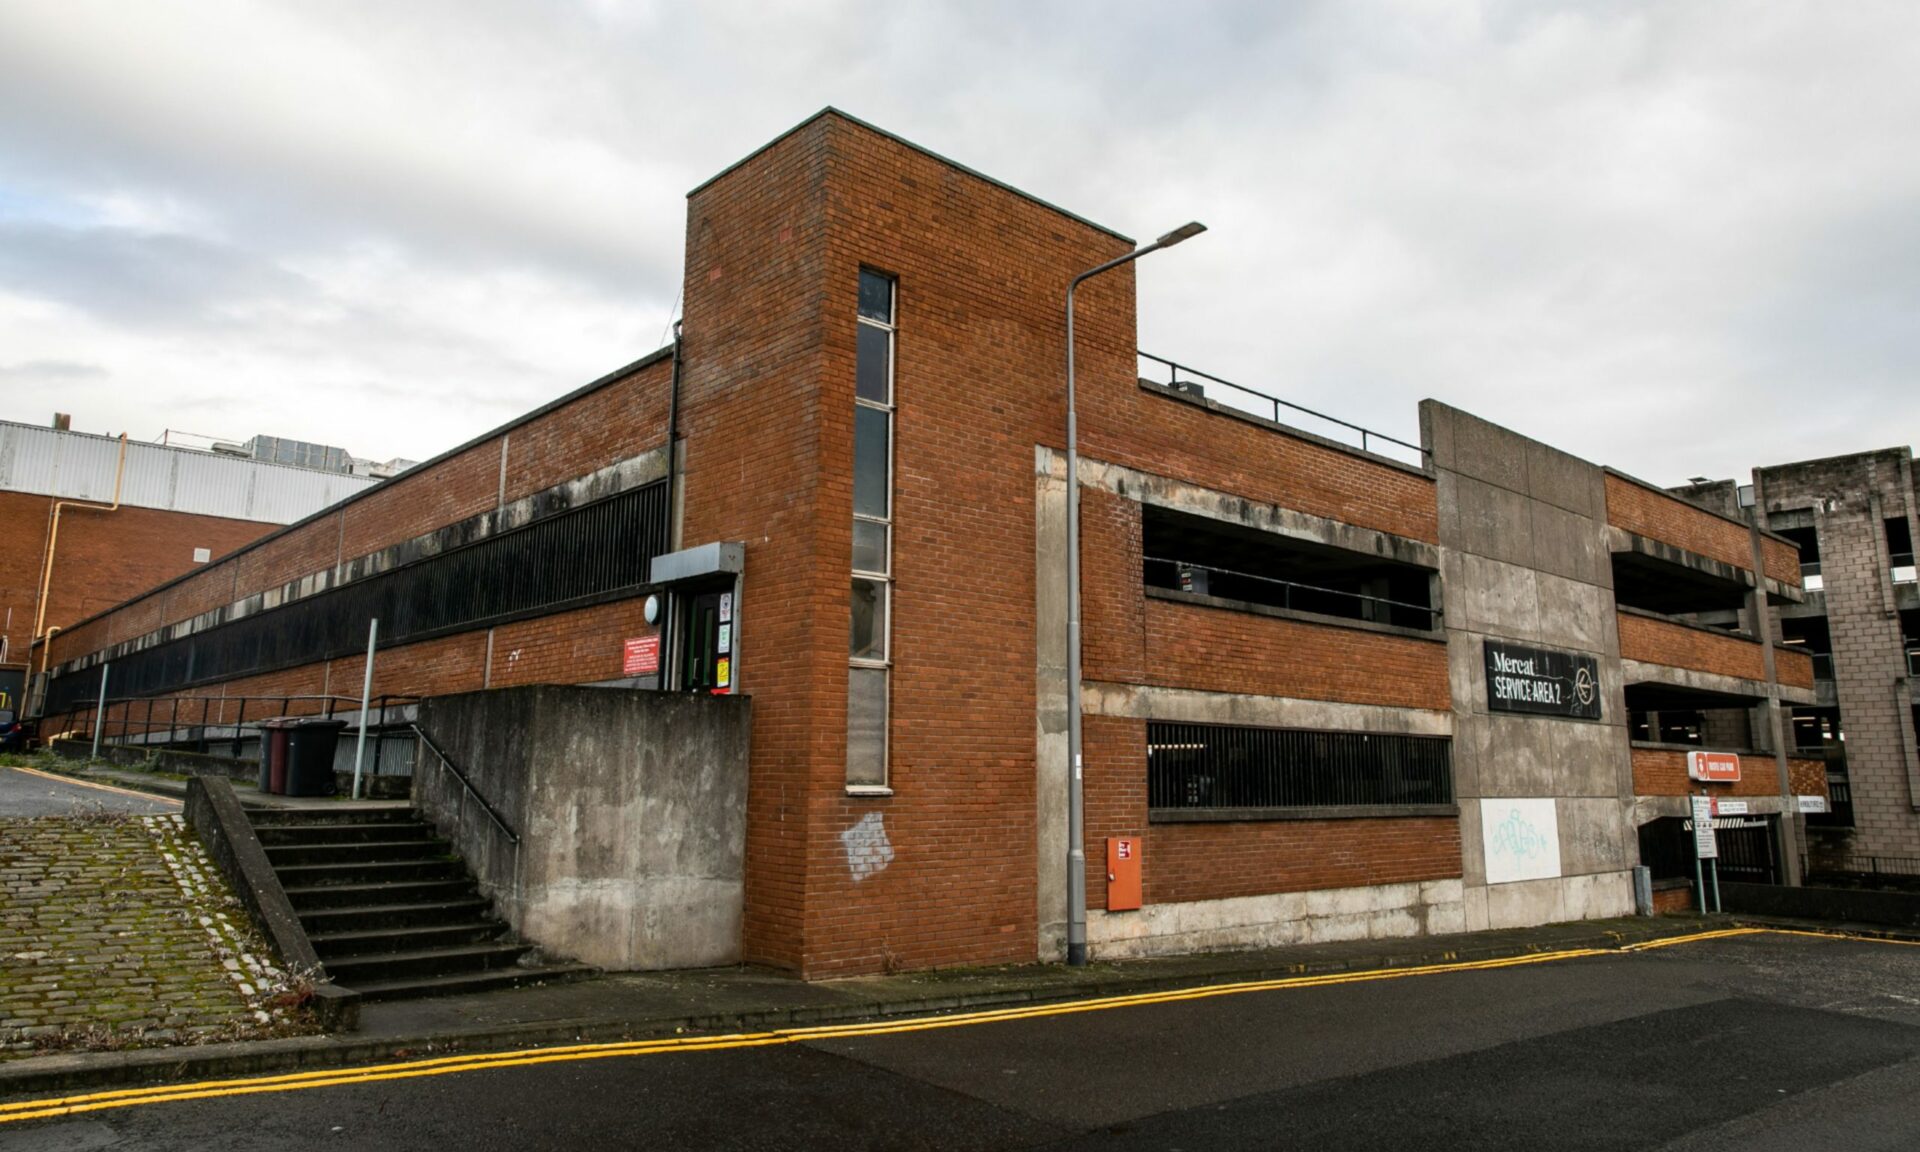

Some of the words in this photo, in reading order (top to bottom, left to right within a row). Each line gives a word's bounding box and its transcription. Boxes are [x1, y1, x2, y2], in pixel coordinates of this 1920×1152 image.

[1493, 651, 1536, 676] Mercat
[1495, 676, 1532, 702] SERVICE
[1533, 680, 1555, 704] AREA
[1555, 682, 1562, 705] 2
